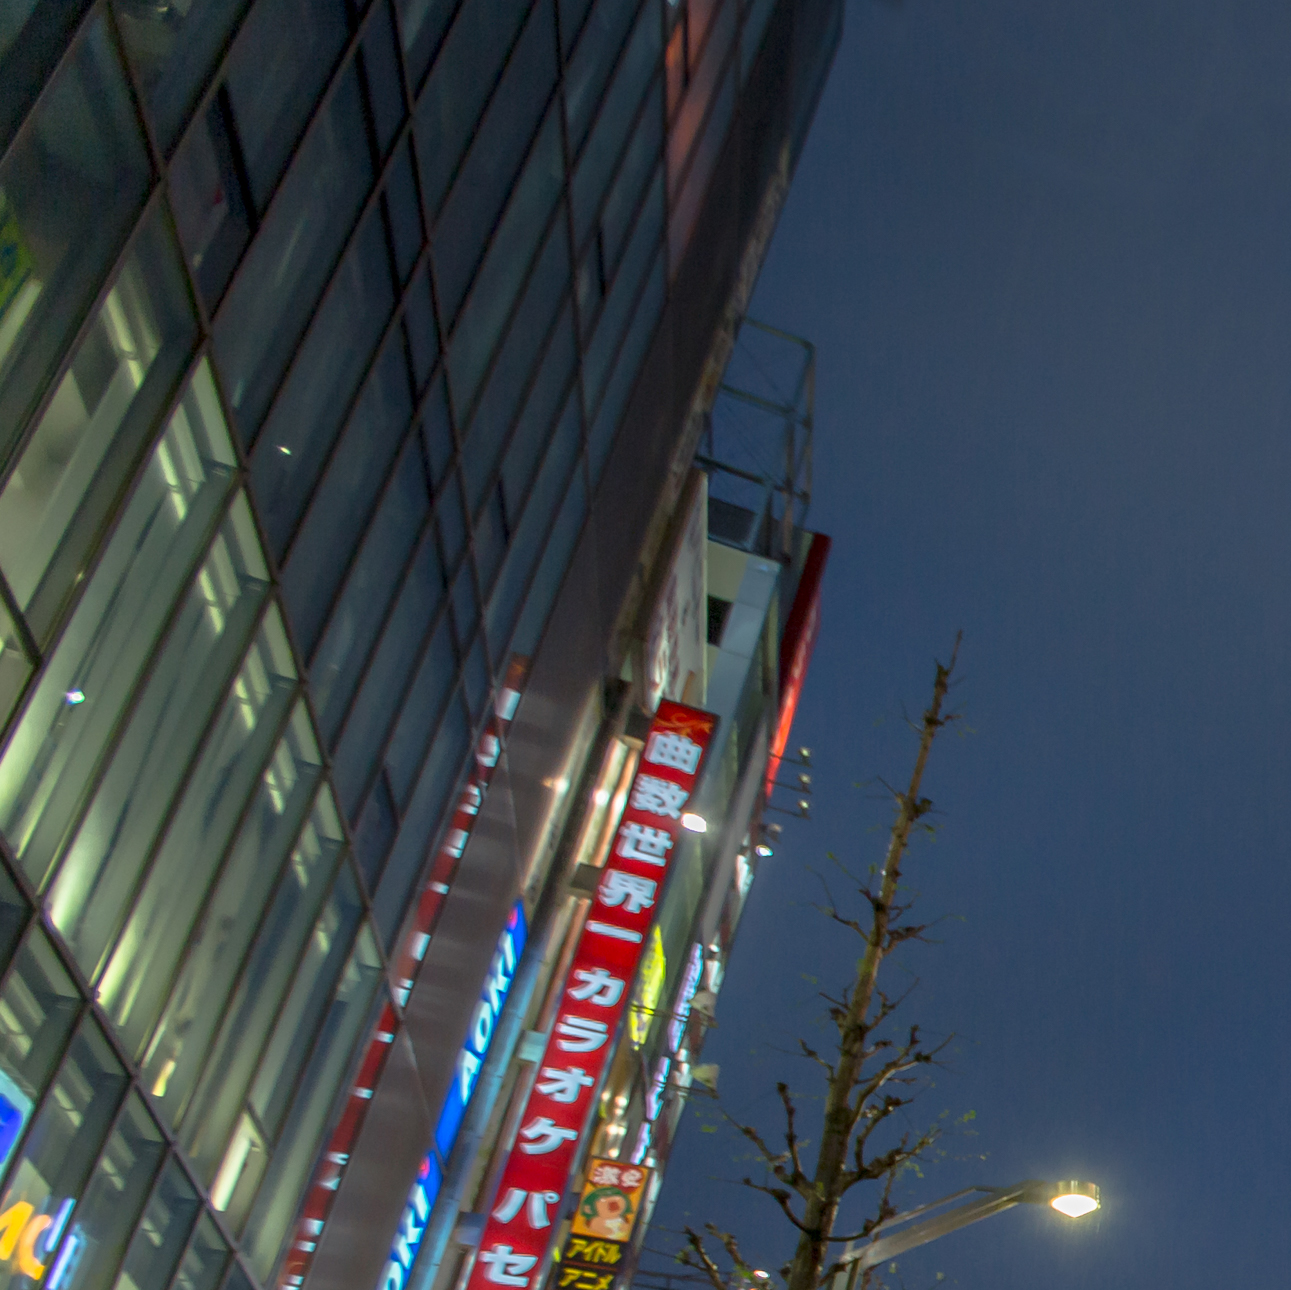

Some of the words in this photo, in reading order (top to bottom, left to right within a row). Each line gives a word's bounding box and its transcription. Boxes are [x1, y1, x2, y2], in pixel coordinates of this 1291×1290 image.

[458, 927, 520, 1105] AOKI
[565, 1237, 622, 1265] アイドル
